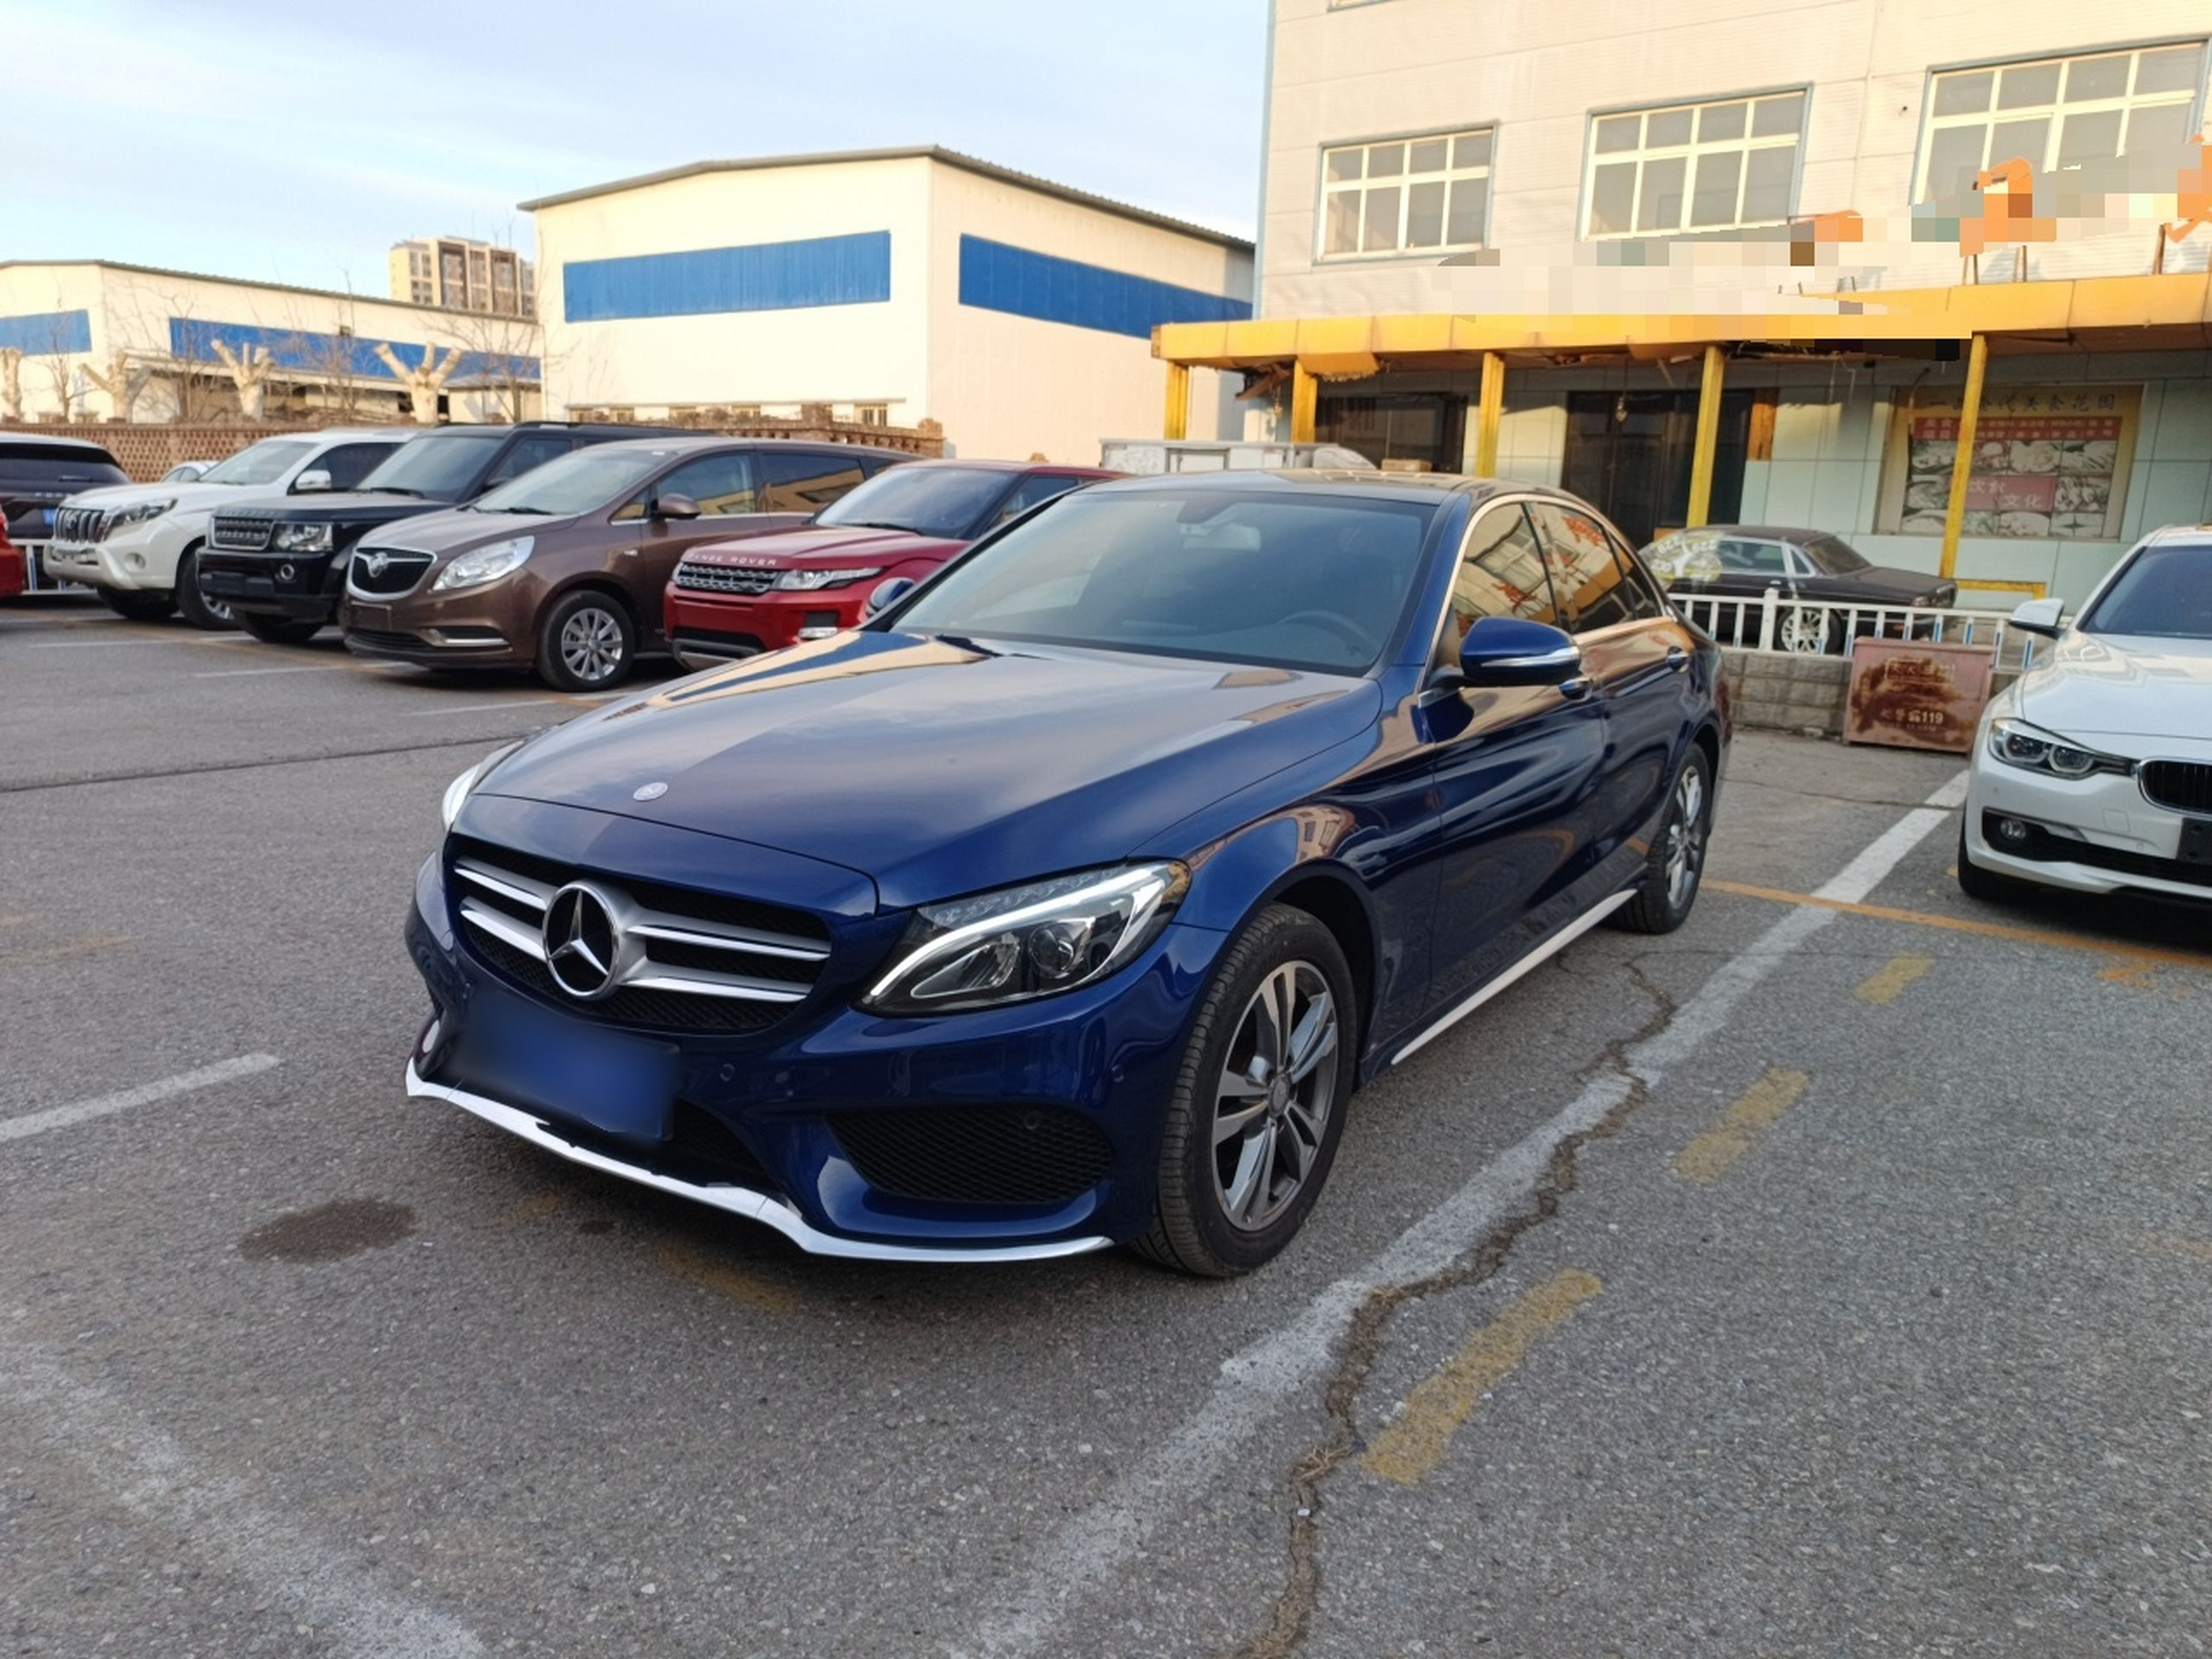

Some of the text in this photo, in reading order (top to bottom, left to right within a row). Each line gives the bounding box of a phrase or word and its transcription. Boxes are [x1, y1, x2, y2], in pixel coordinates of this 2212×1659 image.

[2002, 493, 2042, 509] 文化
[730, 555, 778, 566] ROVER
[1922, 710, 1944, 725] 119
